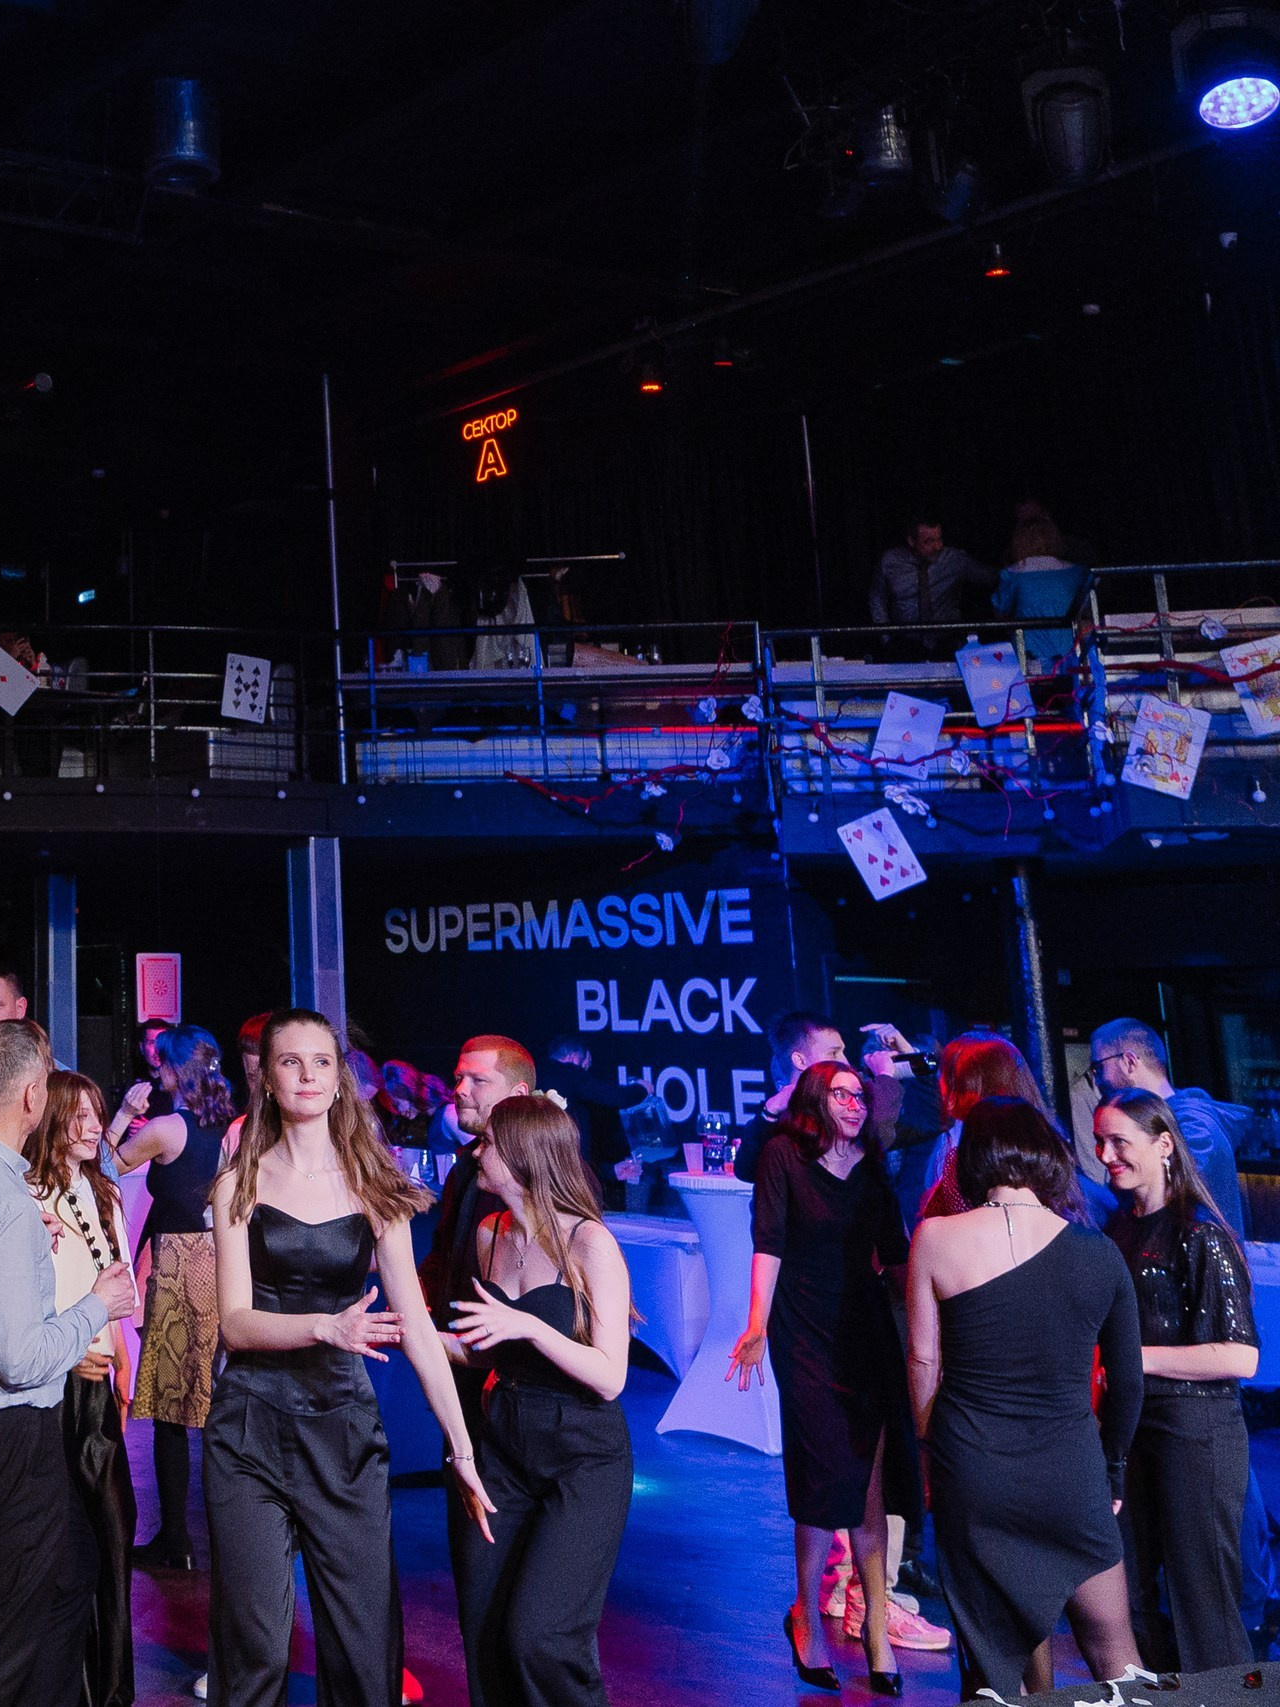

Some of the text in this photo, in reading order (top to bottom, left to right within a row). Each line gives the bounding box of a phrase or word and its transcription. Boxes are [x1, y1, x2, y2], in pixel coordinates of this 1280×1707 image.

[462, 408, 517, 441] СЕКТОР
[384, 888, 754, 954] SUPERMASSIVE
[576, 977, 763, 1034] BLACK
